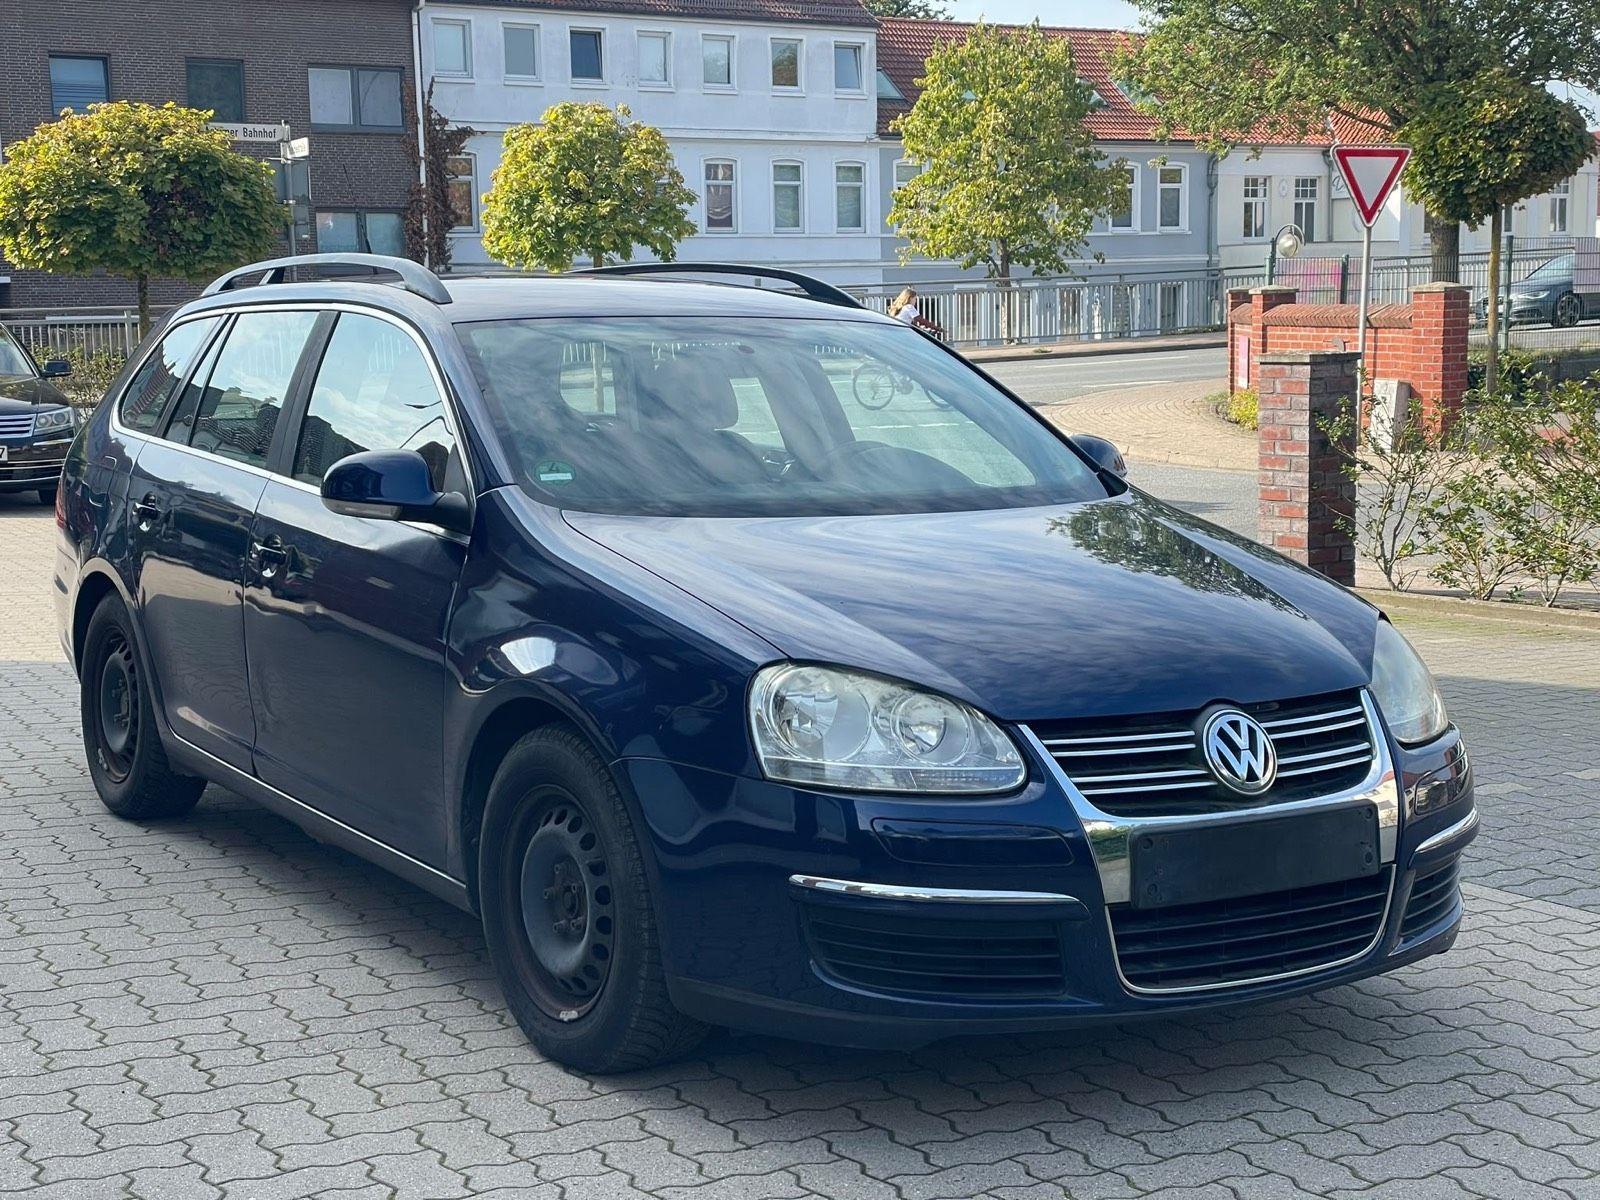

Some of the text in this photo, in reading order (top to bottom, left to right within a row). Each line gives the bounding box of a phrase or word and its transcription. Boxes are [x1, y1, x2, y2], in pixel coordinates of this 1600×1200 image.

[242, 127, 277, 139] Bahnhof
[549, 462, 560, 474] 4
[1208, 715, 1272, 787] VW
